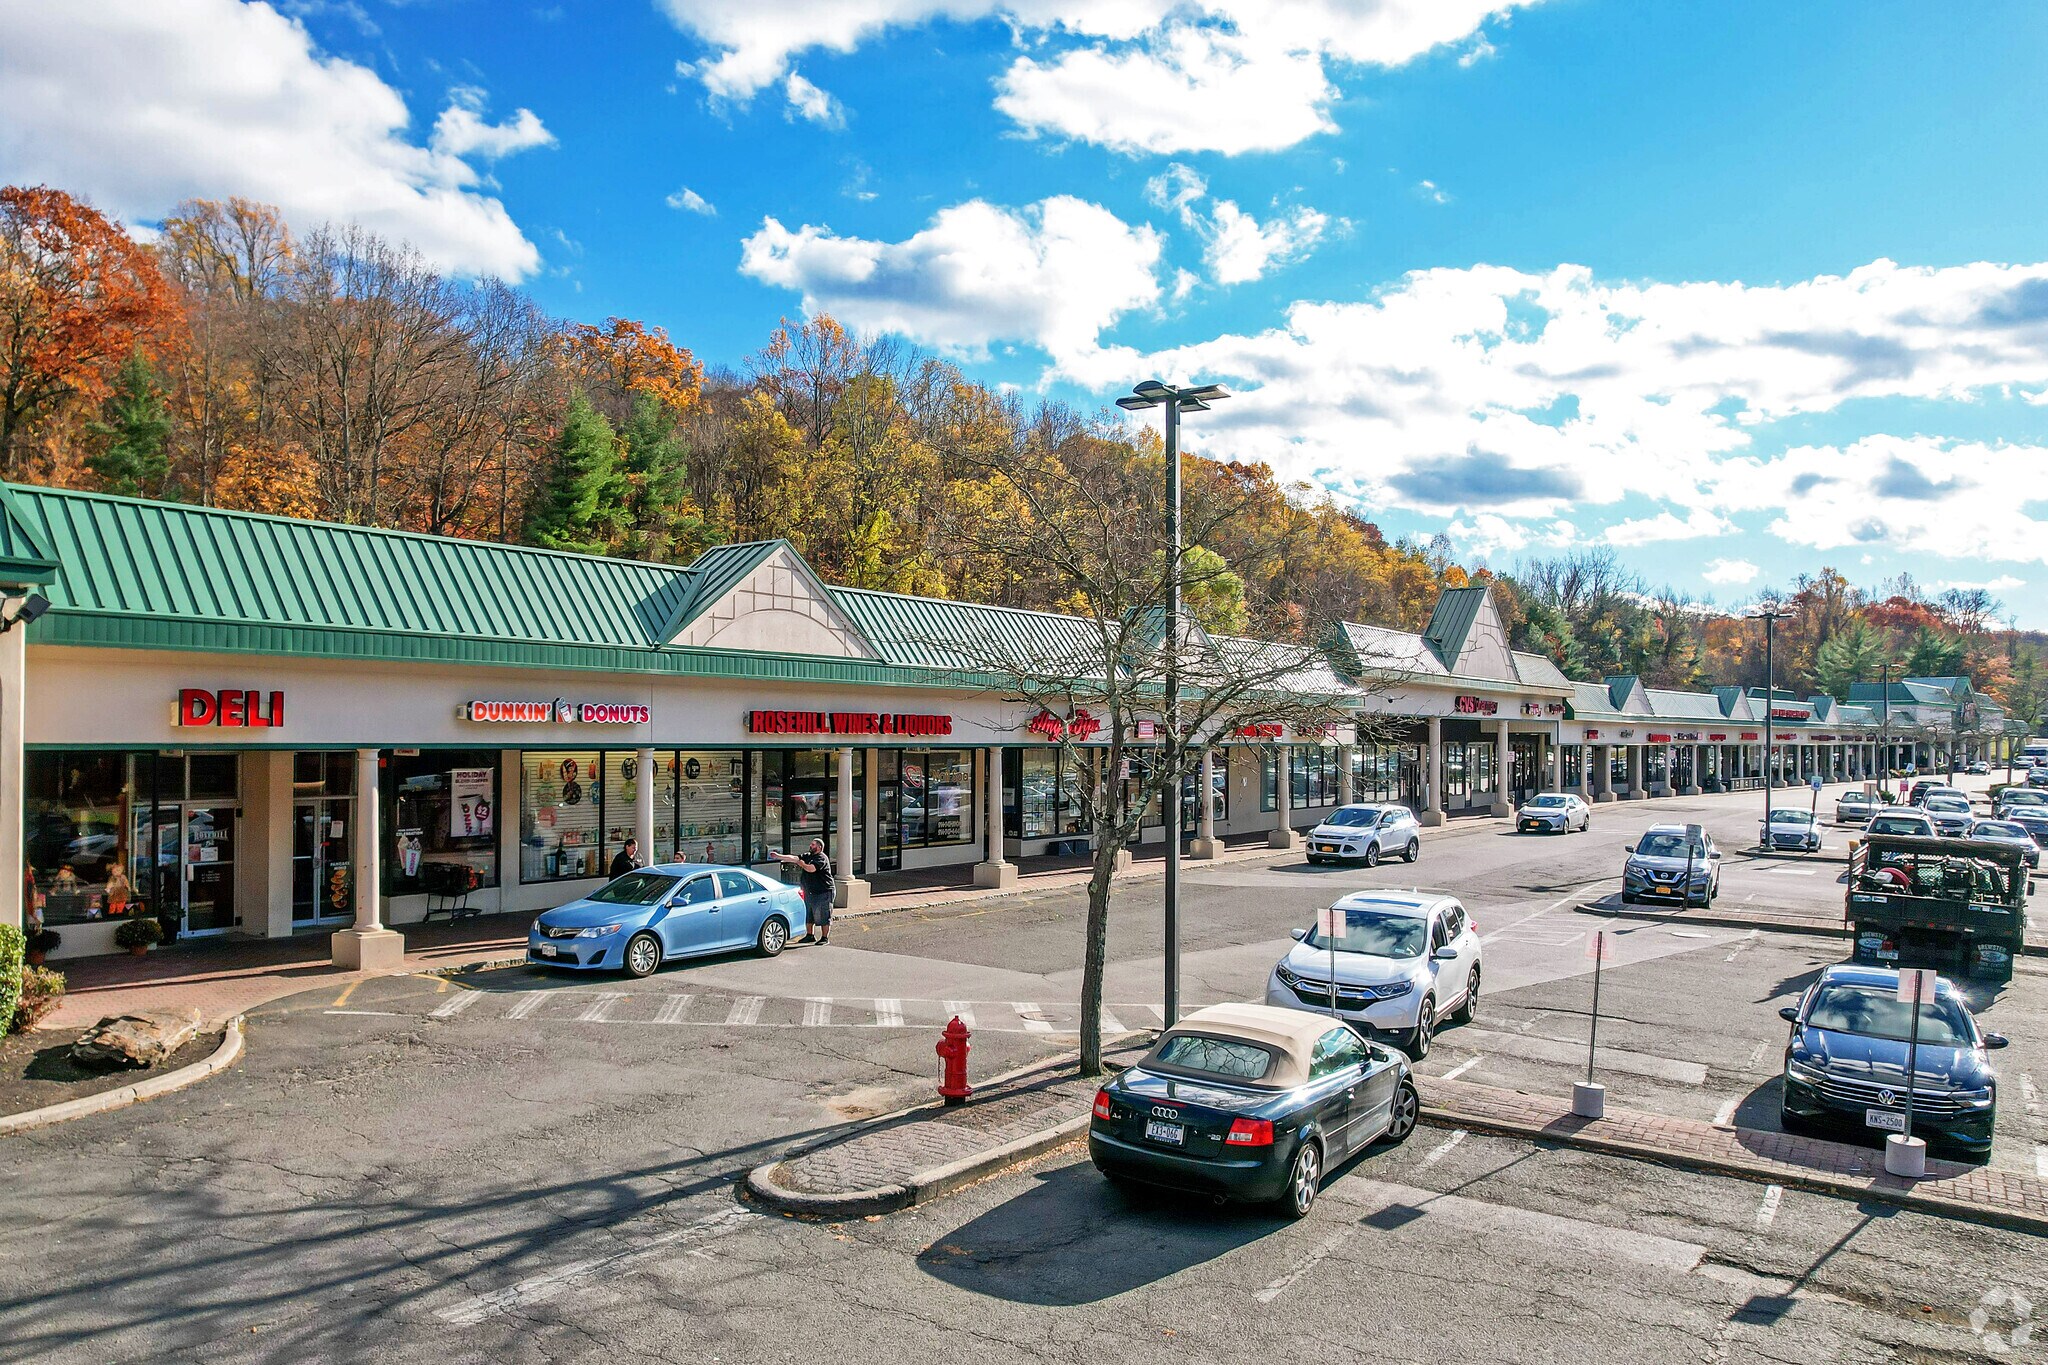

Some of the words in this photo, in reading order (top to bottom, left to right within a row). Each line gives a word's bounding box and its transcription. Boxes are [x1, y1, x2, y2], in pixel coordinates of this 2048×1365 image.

[179, 689, 284, 727] DELI
[473, 702, 551, 721] DUNKIN'
[583, 704, 650, 723] DONUTS
[1459, 696, 1477, 713] CVS
[750, 711, 829, 734] ROSEHILL
[830, 713, 880, 735] WINES
[881, 714, 893, 735] &
[895, 714, 952, 737] LIQUORS
[456, 771, 487, 779] HOLIDAY
[477, 805, 488, 815] $2
